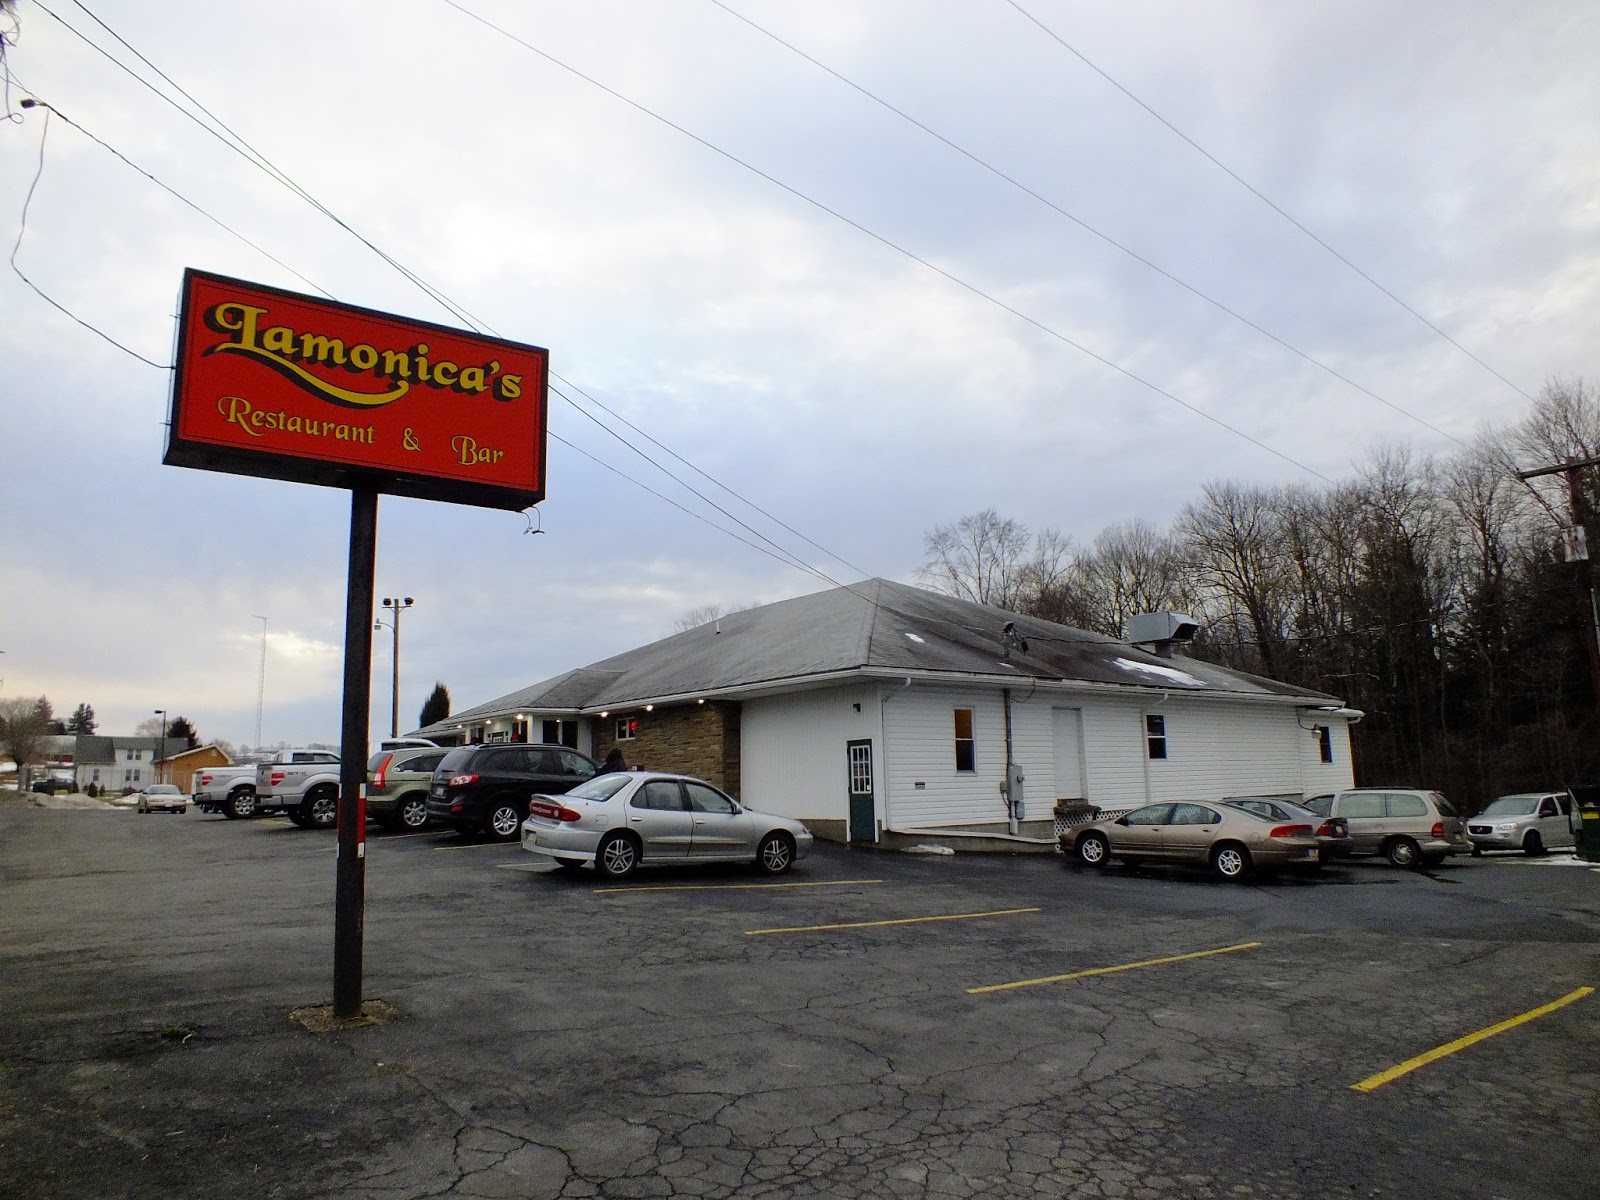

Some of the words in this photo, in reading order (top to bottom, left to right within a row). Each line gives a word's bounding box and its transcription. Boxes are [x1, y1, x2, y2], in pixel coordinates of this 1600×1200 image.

[206, 302, 523, 407] Lamonica's
[217, 395, 375, 444] Restaurant
[402, 427, 422, 452] &
[451, 435, 505, 466] Bar
